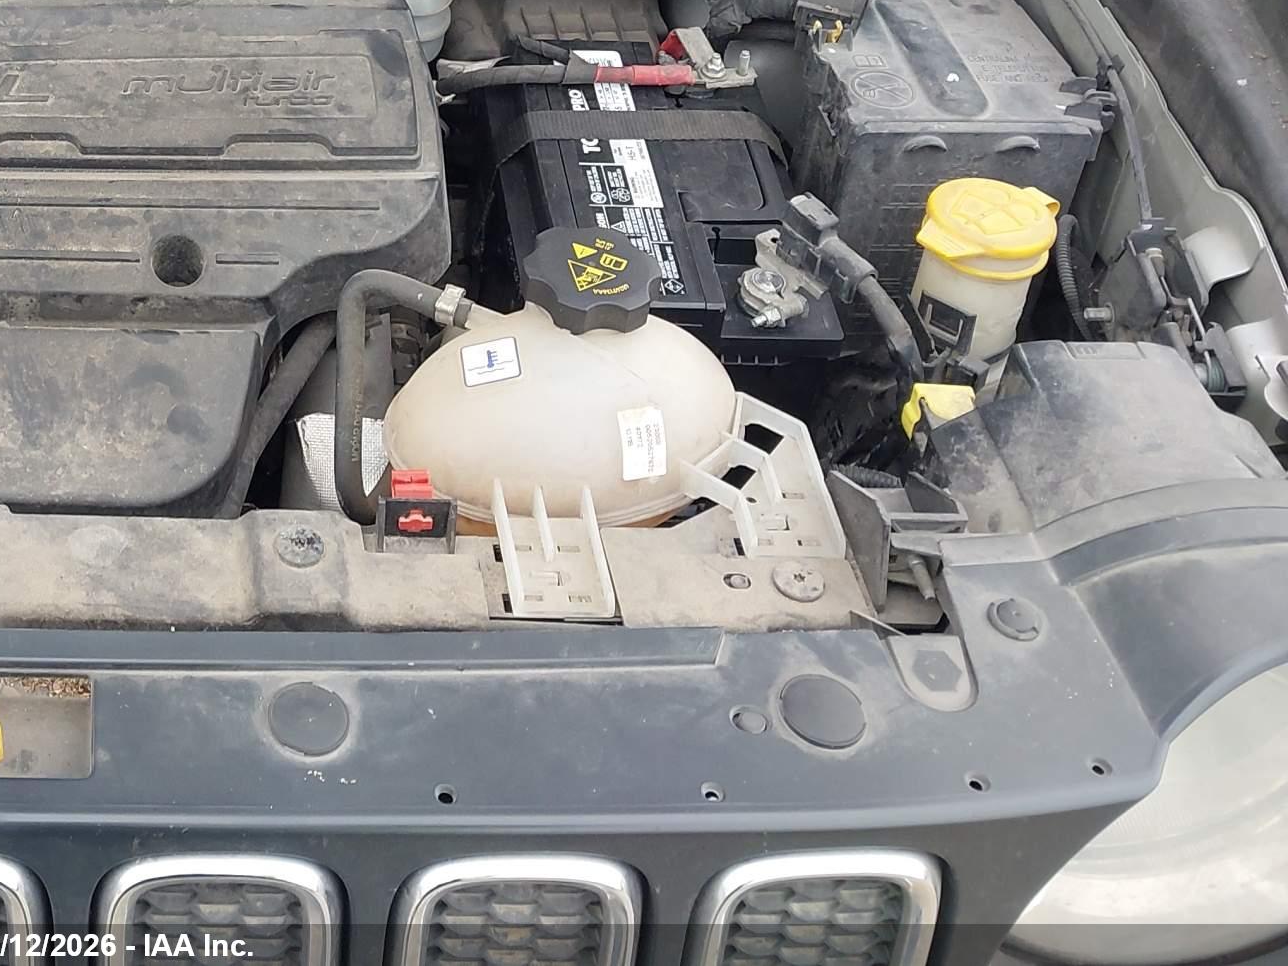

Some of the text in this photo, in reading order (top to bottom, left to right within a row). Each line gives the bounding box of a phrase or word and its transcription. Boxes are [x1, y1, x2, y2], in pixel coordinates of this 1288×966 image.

[122, 65, 338, 95] multiair
[242, 94, 335, 107] turbo
[568, 89, 587, 111] PRO
